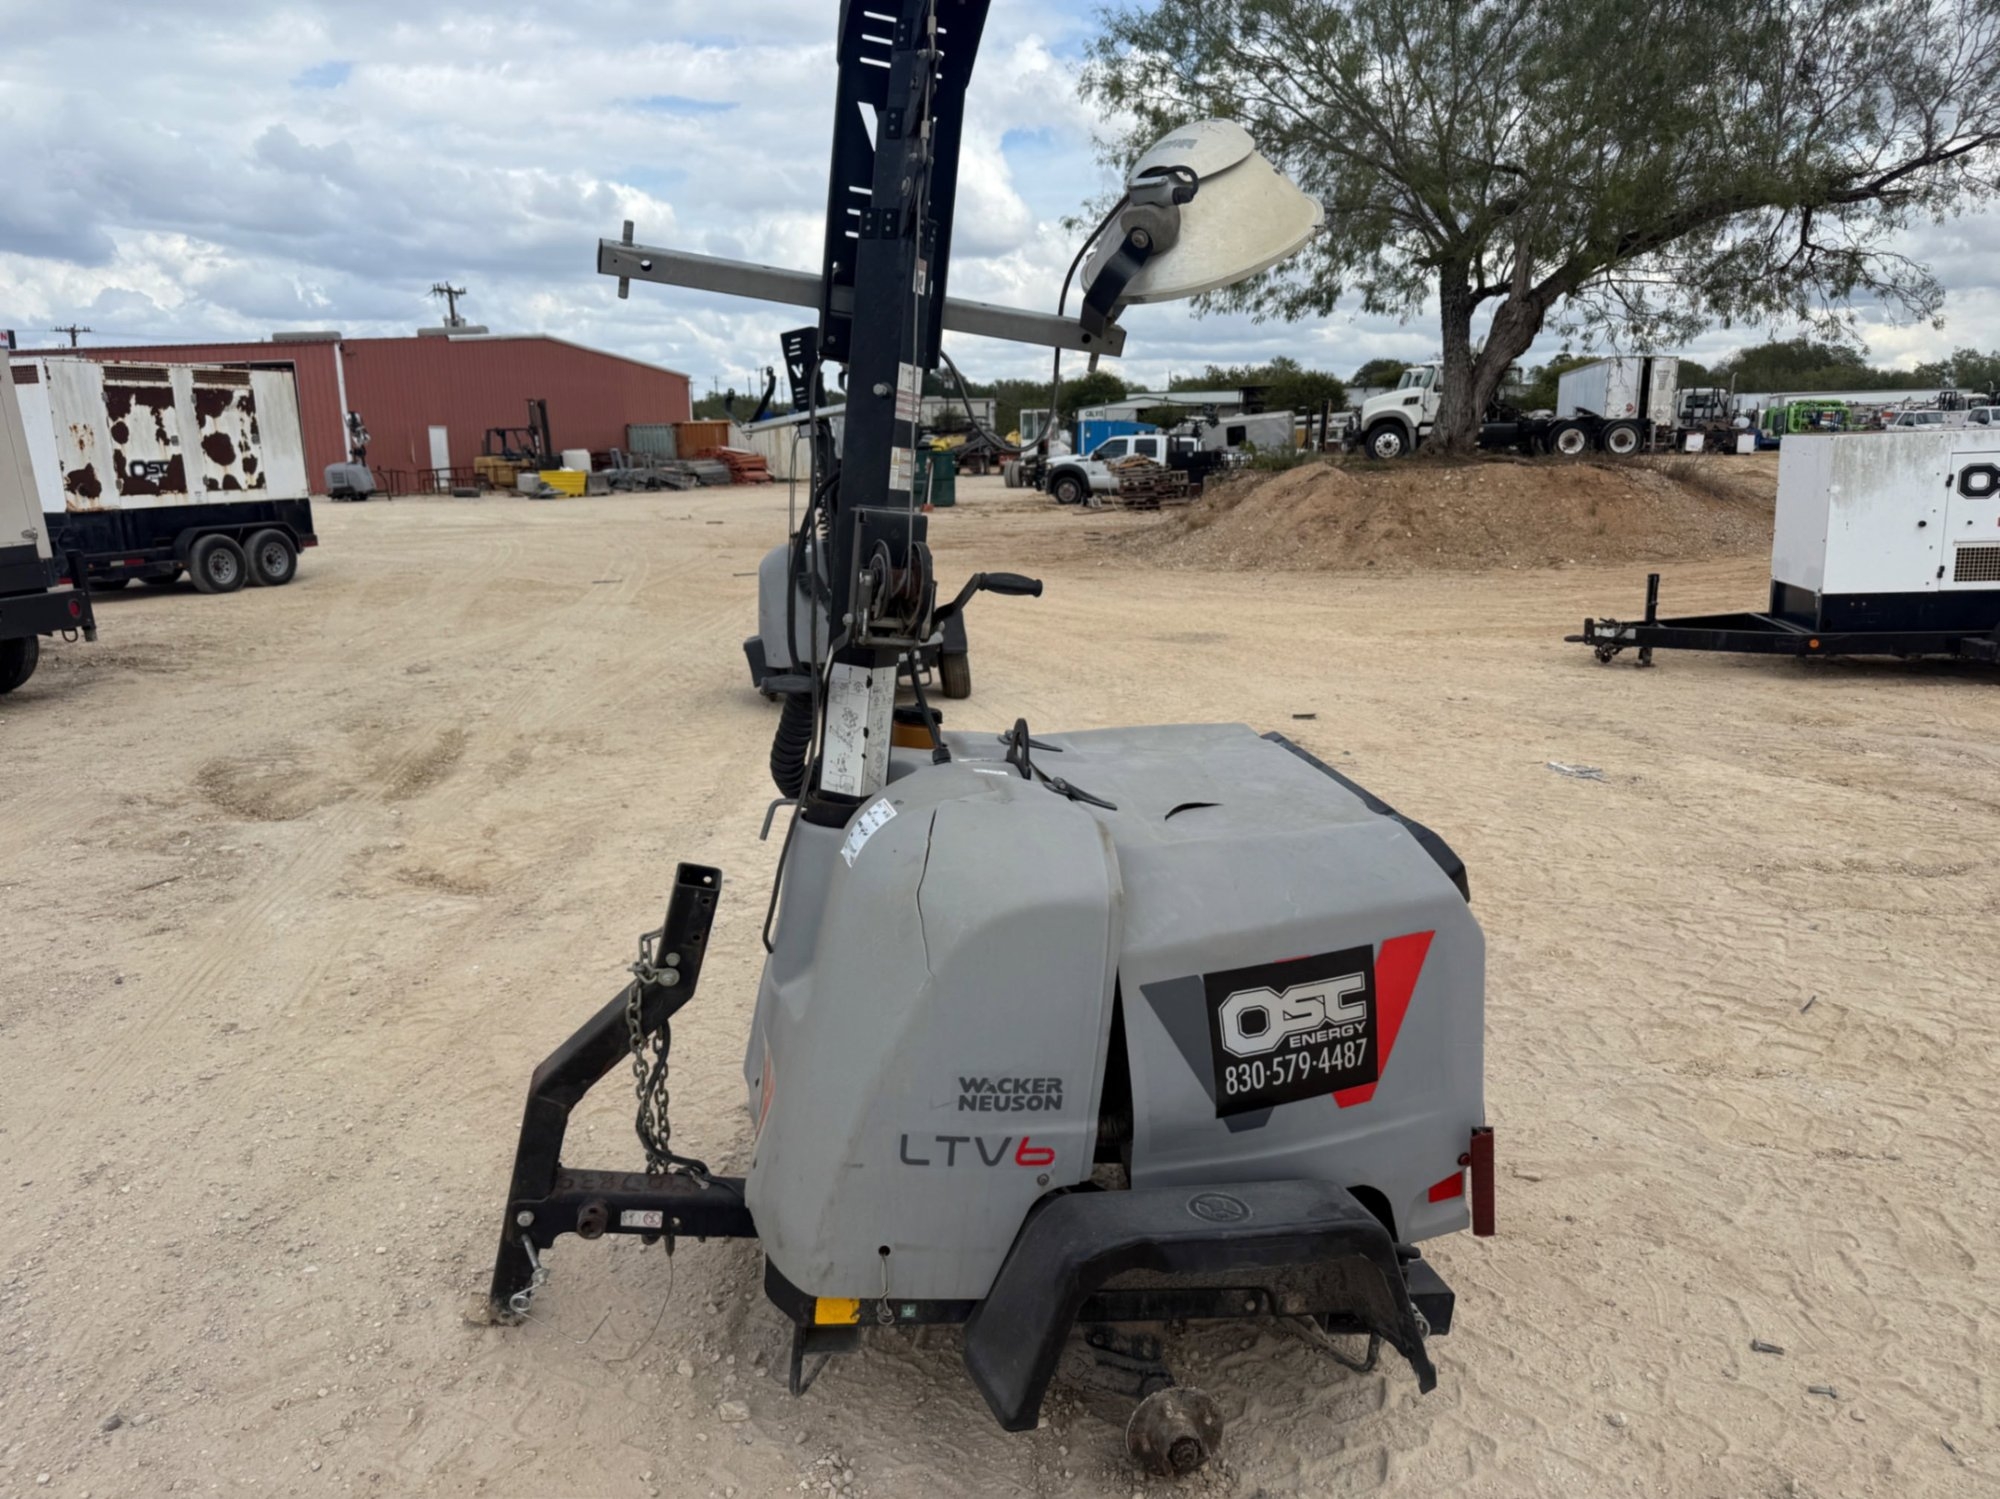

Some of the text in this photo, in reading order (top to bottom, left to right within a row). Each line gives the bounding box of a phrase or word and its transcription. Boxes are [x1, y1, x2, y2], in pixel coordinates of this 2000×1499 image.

[1957, 462, 2000, 499] O
[1218, 971, 1367, 1058] OSC
[1289, 1021, 1367, 1049] ENERGY
[958, 1076, 1063, 1094] WACKER
[958, 1094, 1063, 1112] NEUSON
[900, 1133, 1055, 1167] LTV6
